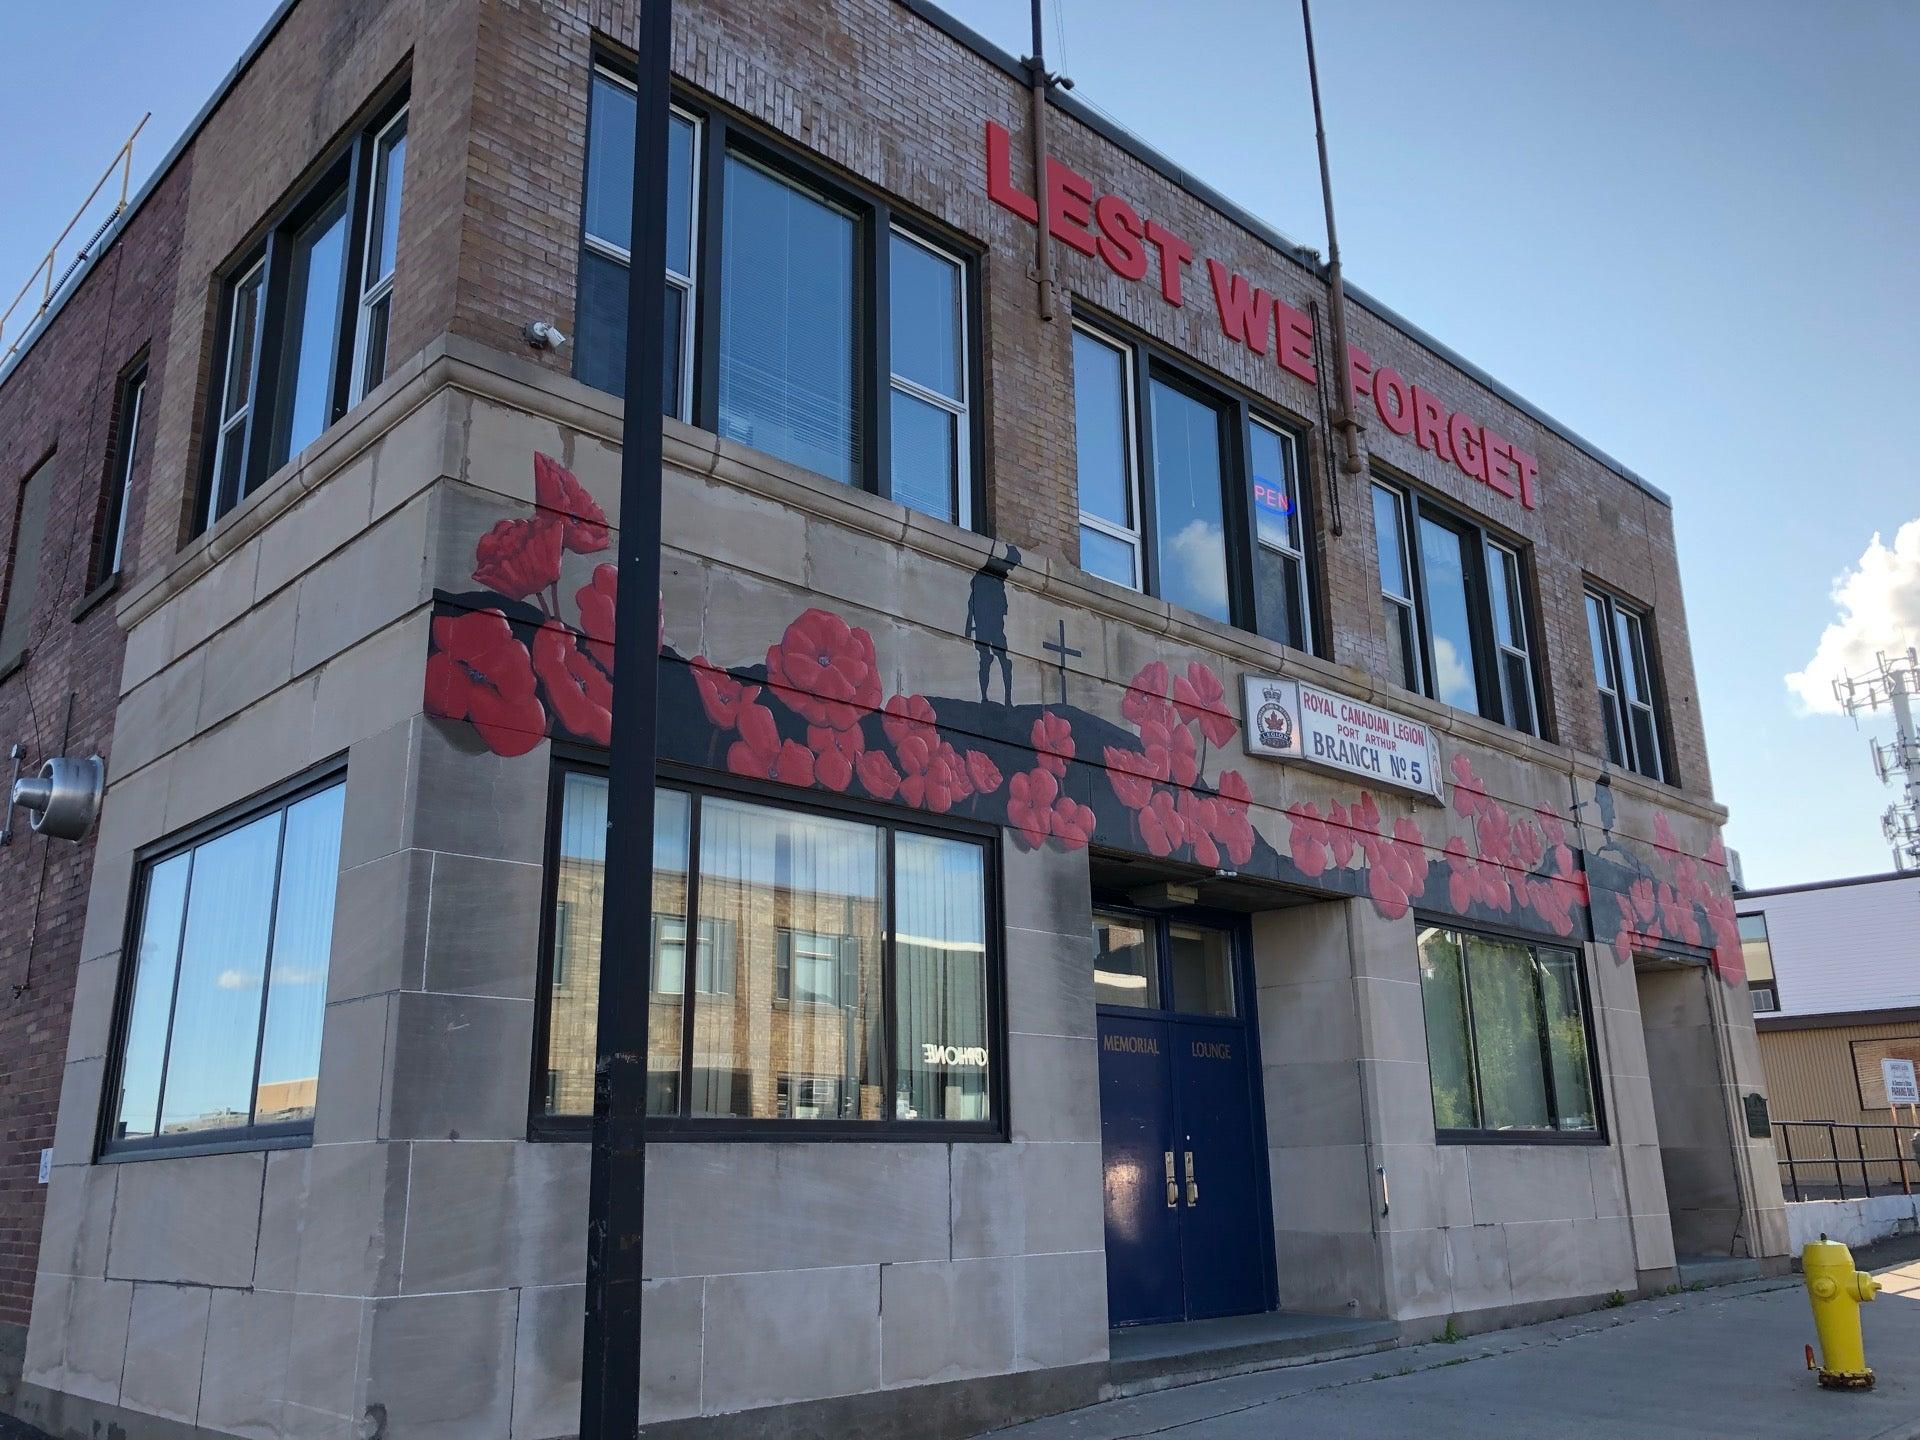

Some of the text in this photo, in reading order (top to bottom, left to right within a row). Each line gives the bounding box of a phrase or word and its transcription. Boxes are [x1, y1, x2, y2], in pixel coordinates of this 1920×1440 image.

[986, 121, 1539, 511] LEST WE FORGET
[1254, 484, 1288, 511] PEN
[1303, 691, 1338, 719] ROYAL
[1340, 704, 1390, 736] CANADIAN
[1393, 721, 1425, 747] LEGION
[1261, 731, 1289, 741] LEGION
[1337, 724, 1397, 752] PORT ARTHUR
[1313, 730, 1381, 773] BRANCH
[1411, 761, 1423, 785] 5
[1103, 1034, 1232, 1060] MEMORIAL LOUNGE
